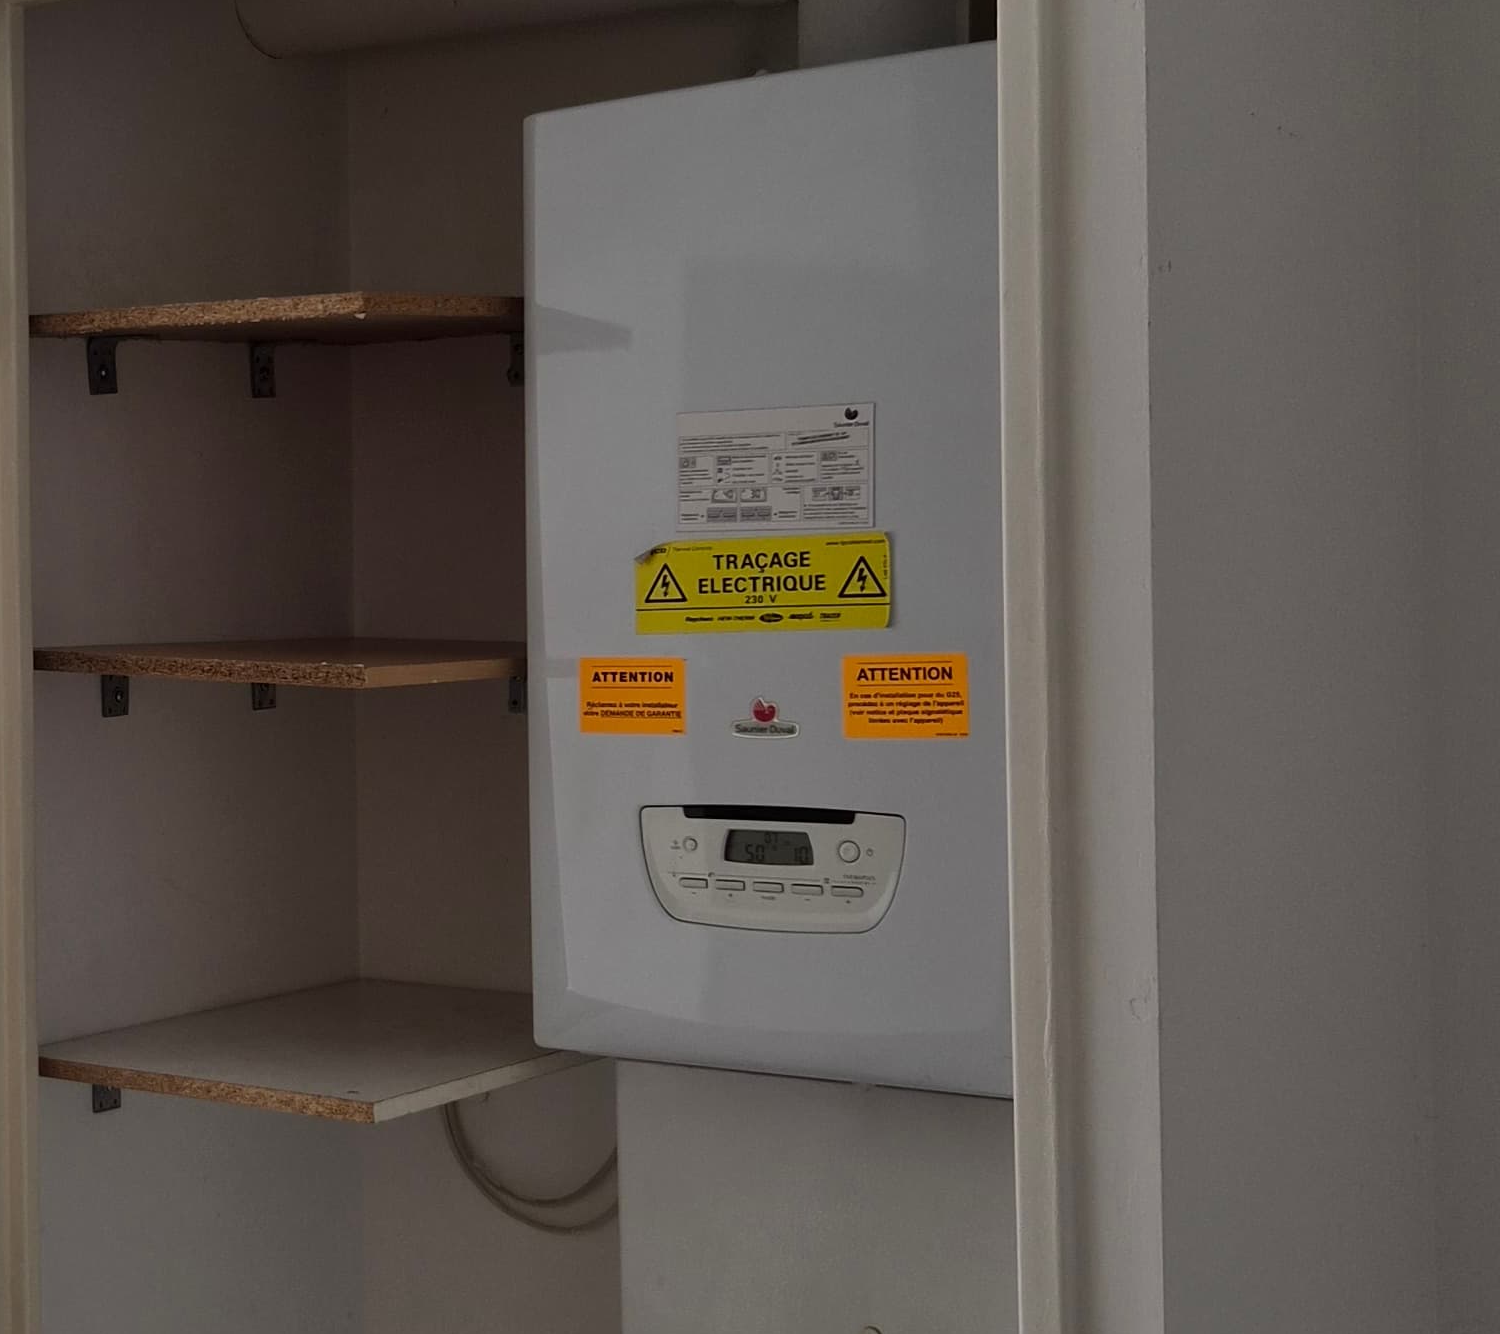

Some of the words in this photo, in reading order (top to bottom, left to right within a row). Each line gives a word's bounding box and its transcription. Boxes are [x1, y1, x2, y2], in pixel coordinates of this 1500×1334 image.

[712, 551, 810, 573] TRAÇAGE
[698, 574, 826, 594] ELECTRIQUE
[744, 595, 764, 604] 230
[769, 594, 778, 603] V
[592, 671, 674, 683] ATTENTION
[856, 666, 953, 681] ATTENTION
[744, 844, 765, 862] 50
